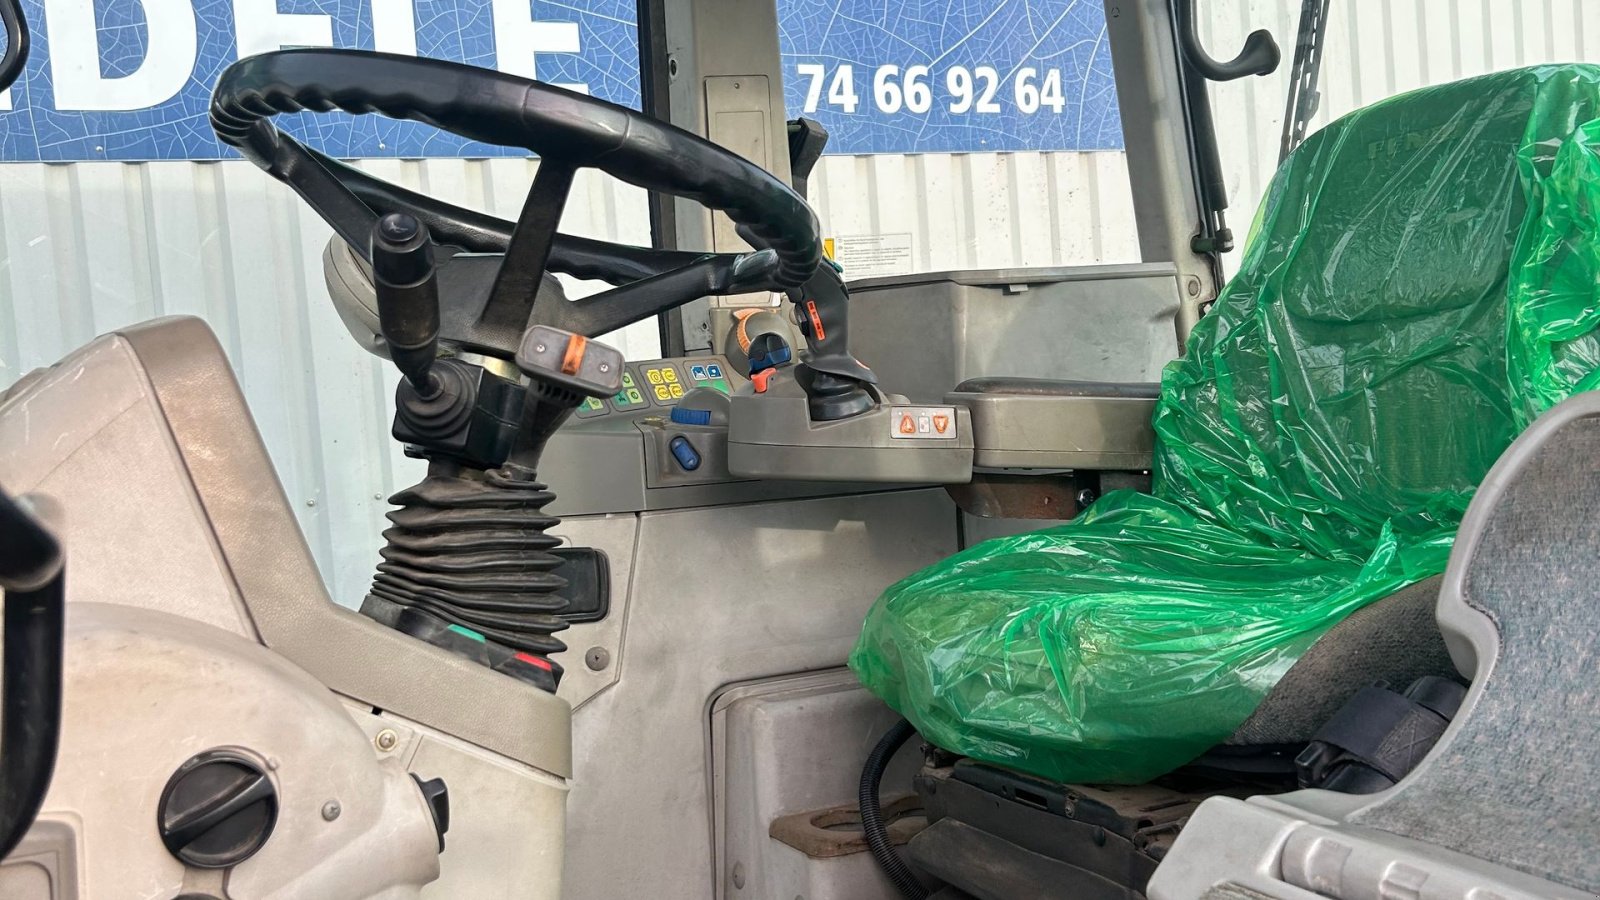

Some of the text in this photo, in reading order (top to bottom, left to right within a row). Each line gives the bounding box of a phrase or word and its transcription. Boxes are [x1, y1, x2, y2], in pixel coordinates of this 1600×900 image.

[797, 64, 1065, 114] 74 66 92 64
